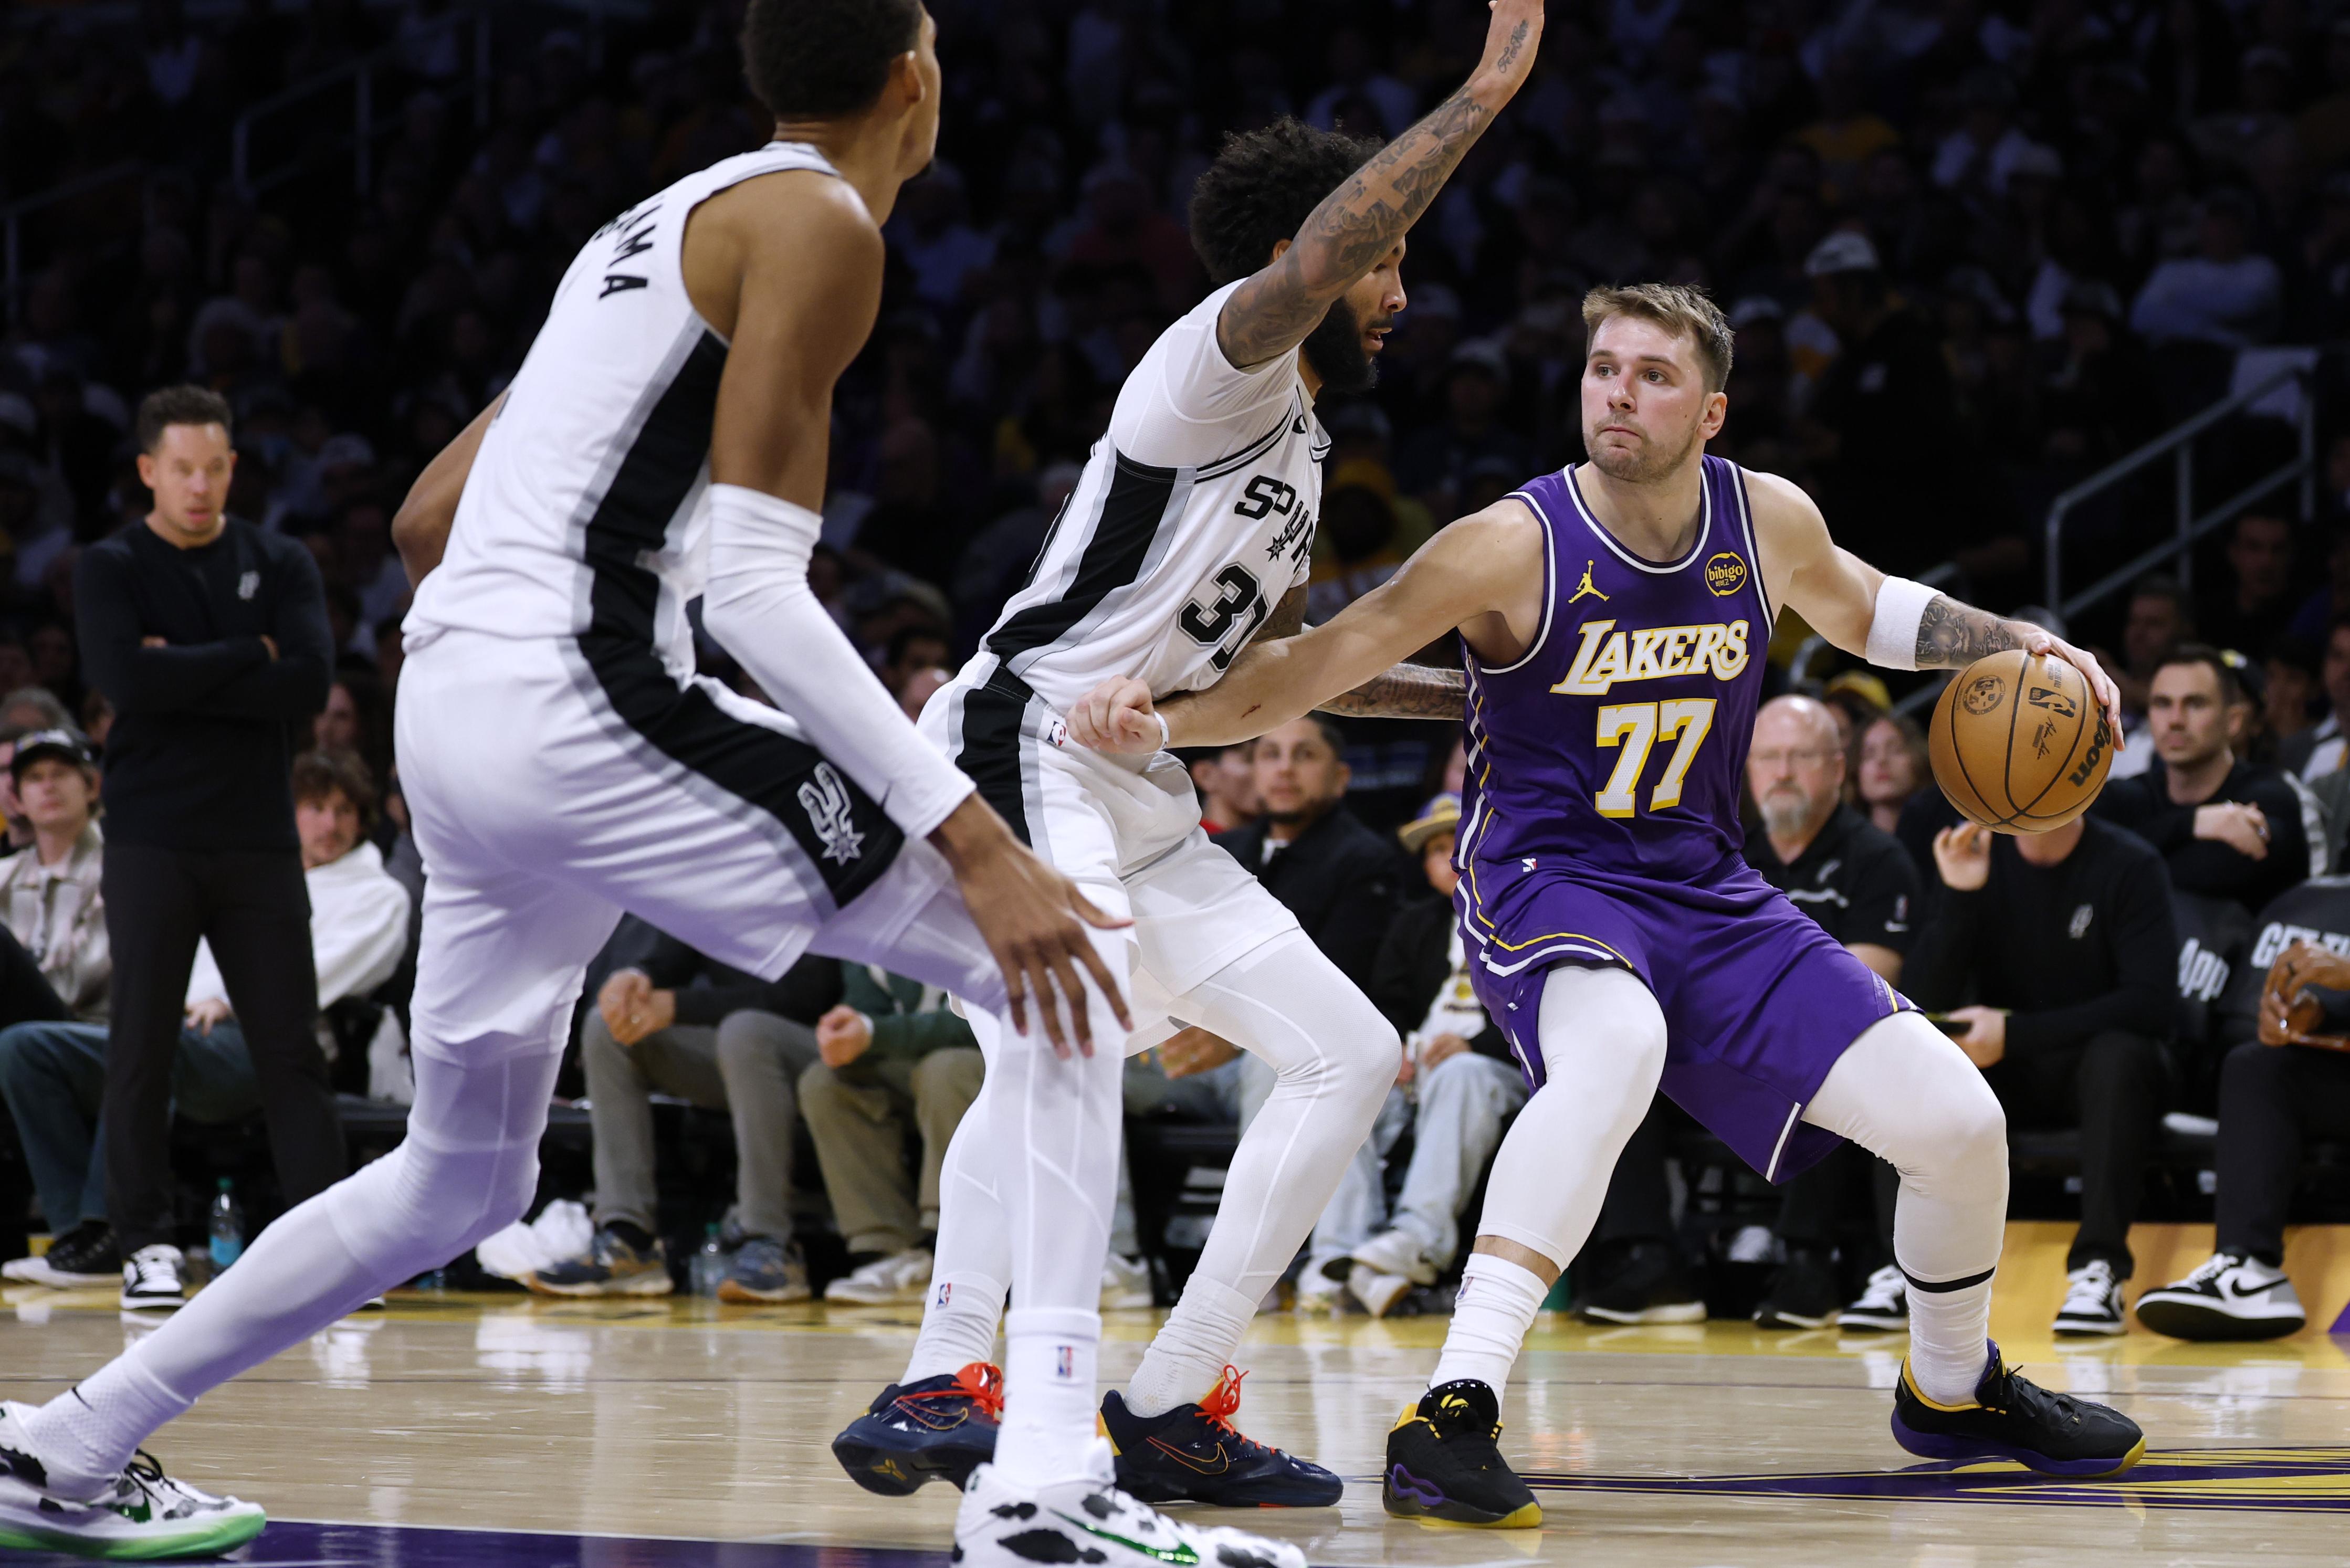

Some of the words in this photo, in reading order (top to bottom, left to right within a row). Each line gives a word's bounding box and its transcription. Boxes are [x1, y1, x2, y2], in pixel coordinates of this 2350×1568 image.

[1708, 564, 1744, 582] bibigo
[1715, 578, 1730, 587] 비비고
[1549, 619, 1750, 696] LAKERS
[1595, 698, 1717, 818] 77
